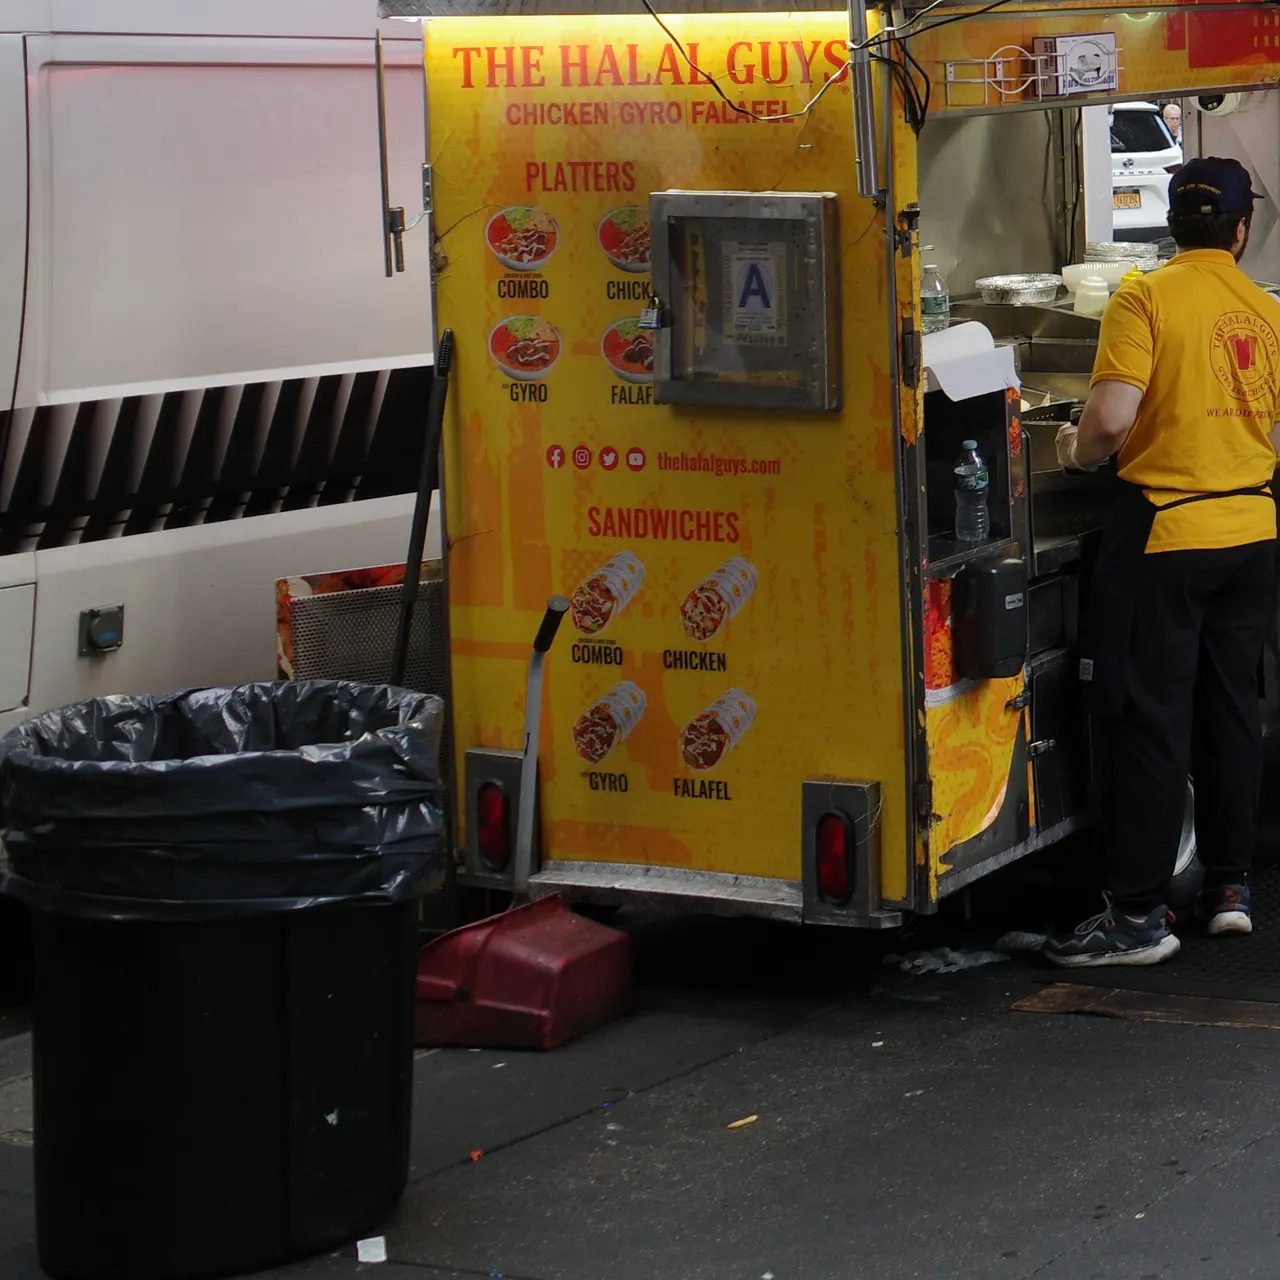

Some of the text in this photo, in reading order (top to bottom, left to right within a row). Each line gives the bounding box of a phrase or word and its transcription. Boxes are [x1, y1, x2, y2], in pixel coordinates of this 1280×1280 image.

[452, 45, 545, 89] THE
[559, 43, 712, 87] HALAL
[505, 100, 795, 126] CHICKEN GYRO FALAFEL
[525, 161, 635, 193] PLATTERS
[498, 280, 650, 300] COMBO CHICK
[738, 263, 772, 309] A
[510, 383, 547, 402] GYRO
[657, 450, 781, 477] thehalalguys.com
[588, 506, 740, 543] SANDWICHES
[572, 644, 726, 671] COMBO CHICKEN
[589, 772, 732, 800] GYRO FALAFEL
